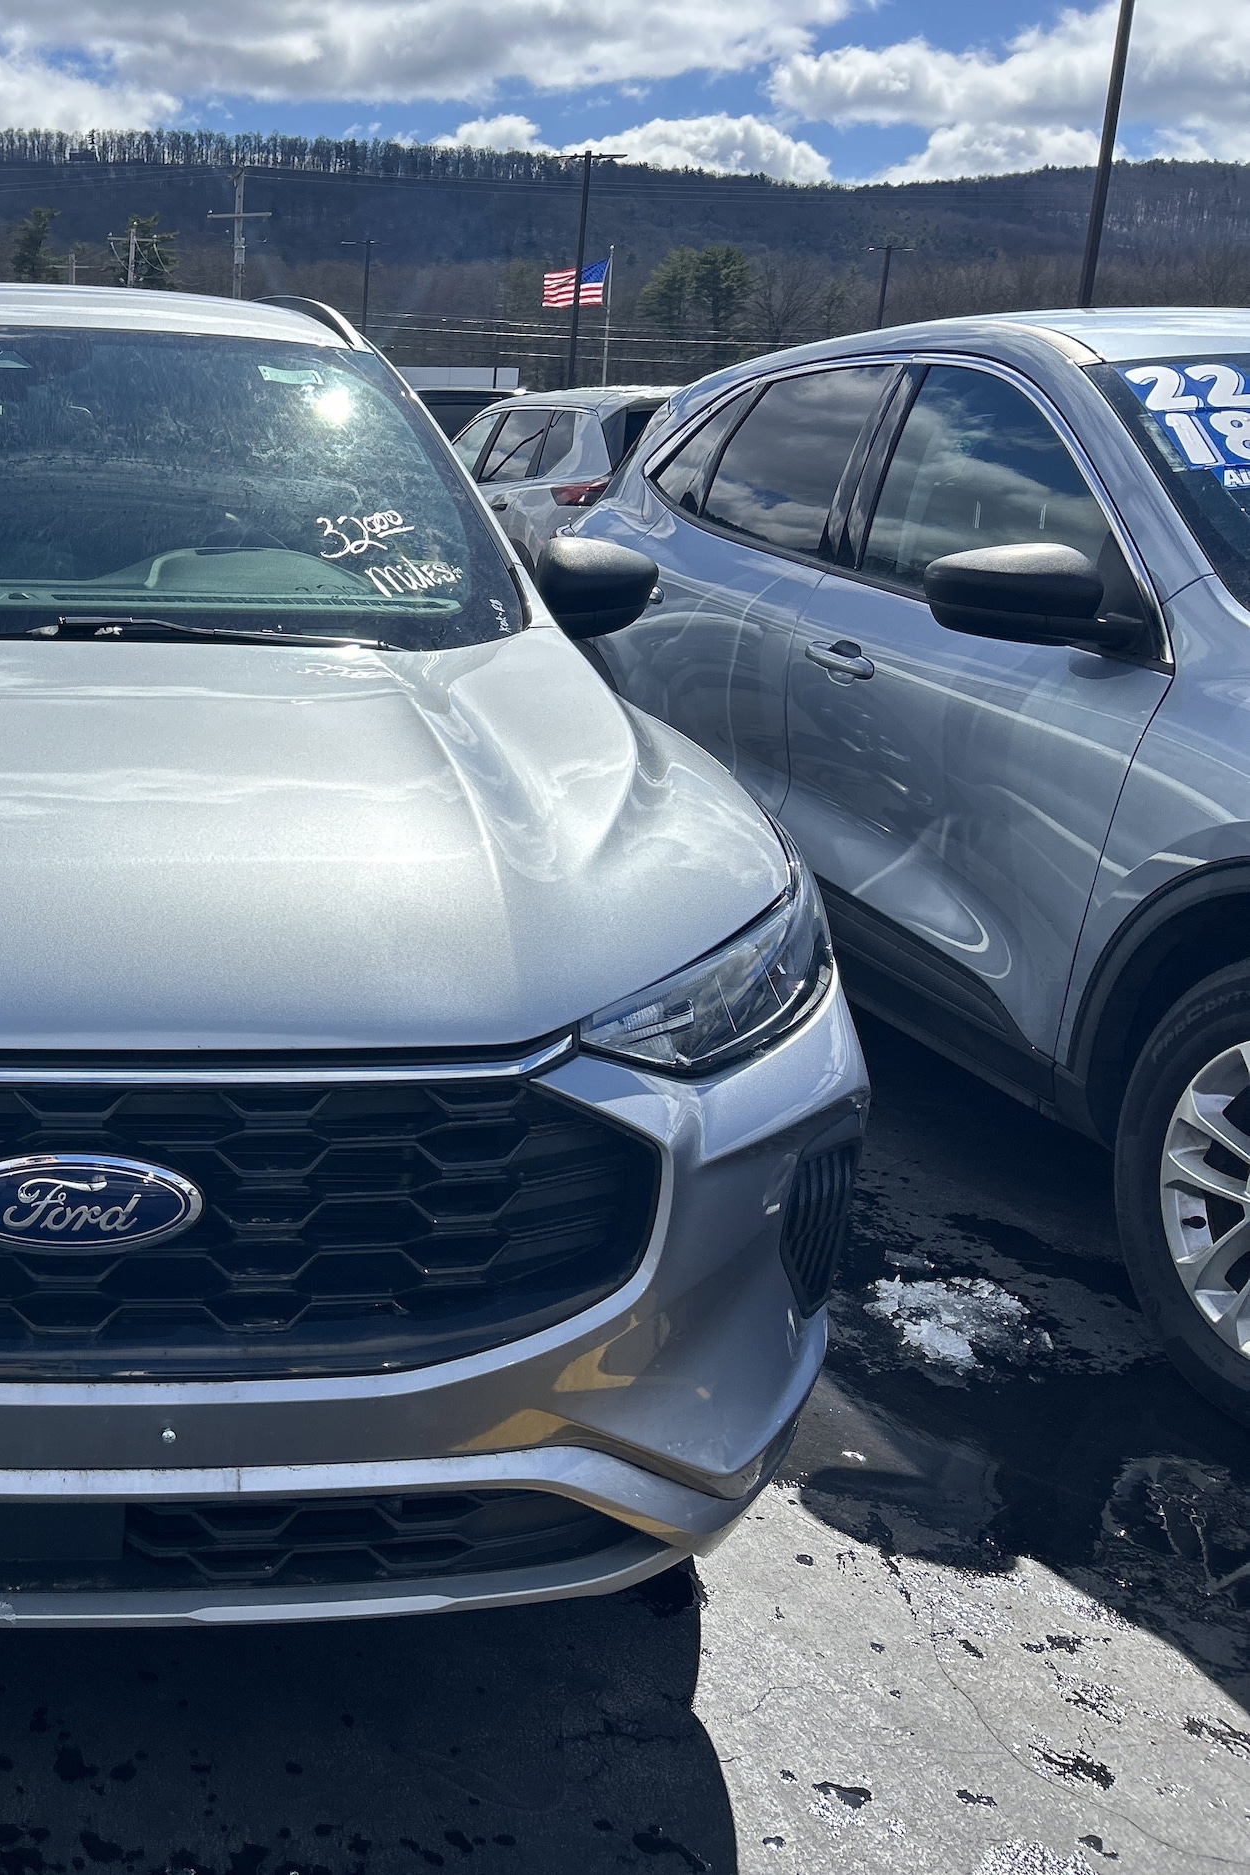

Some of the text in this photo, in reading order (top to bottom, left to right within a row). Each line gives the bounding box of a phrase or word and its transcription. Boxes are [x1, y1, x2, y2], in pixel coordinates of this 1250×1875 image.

[1124, 363, 1250, 411] 22
[1223, 468, 1250, 488] AL
[2, 1177, 142, 1232] Ford
